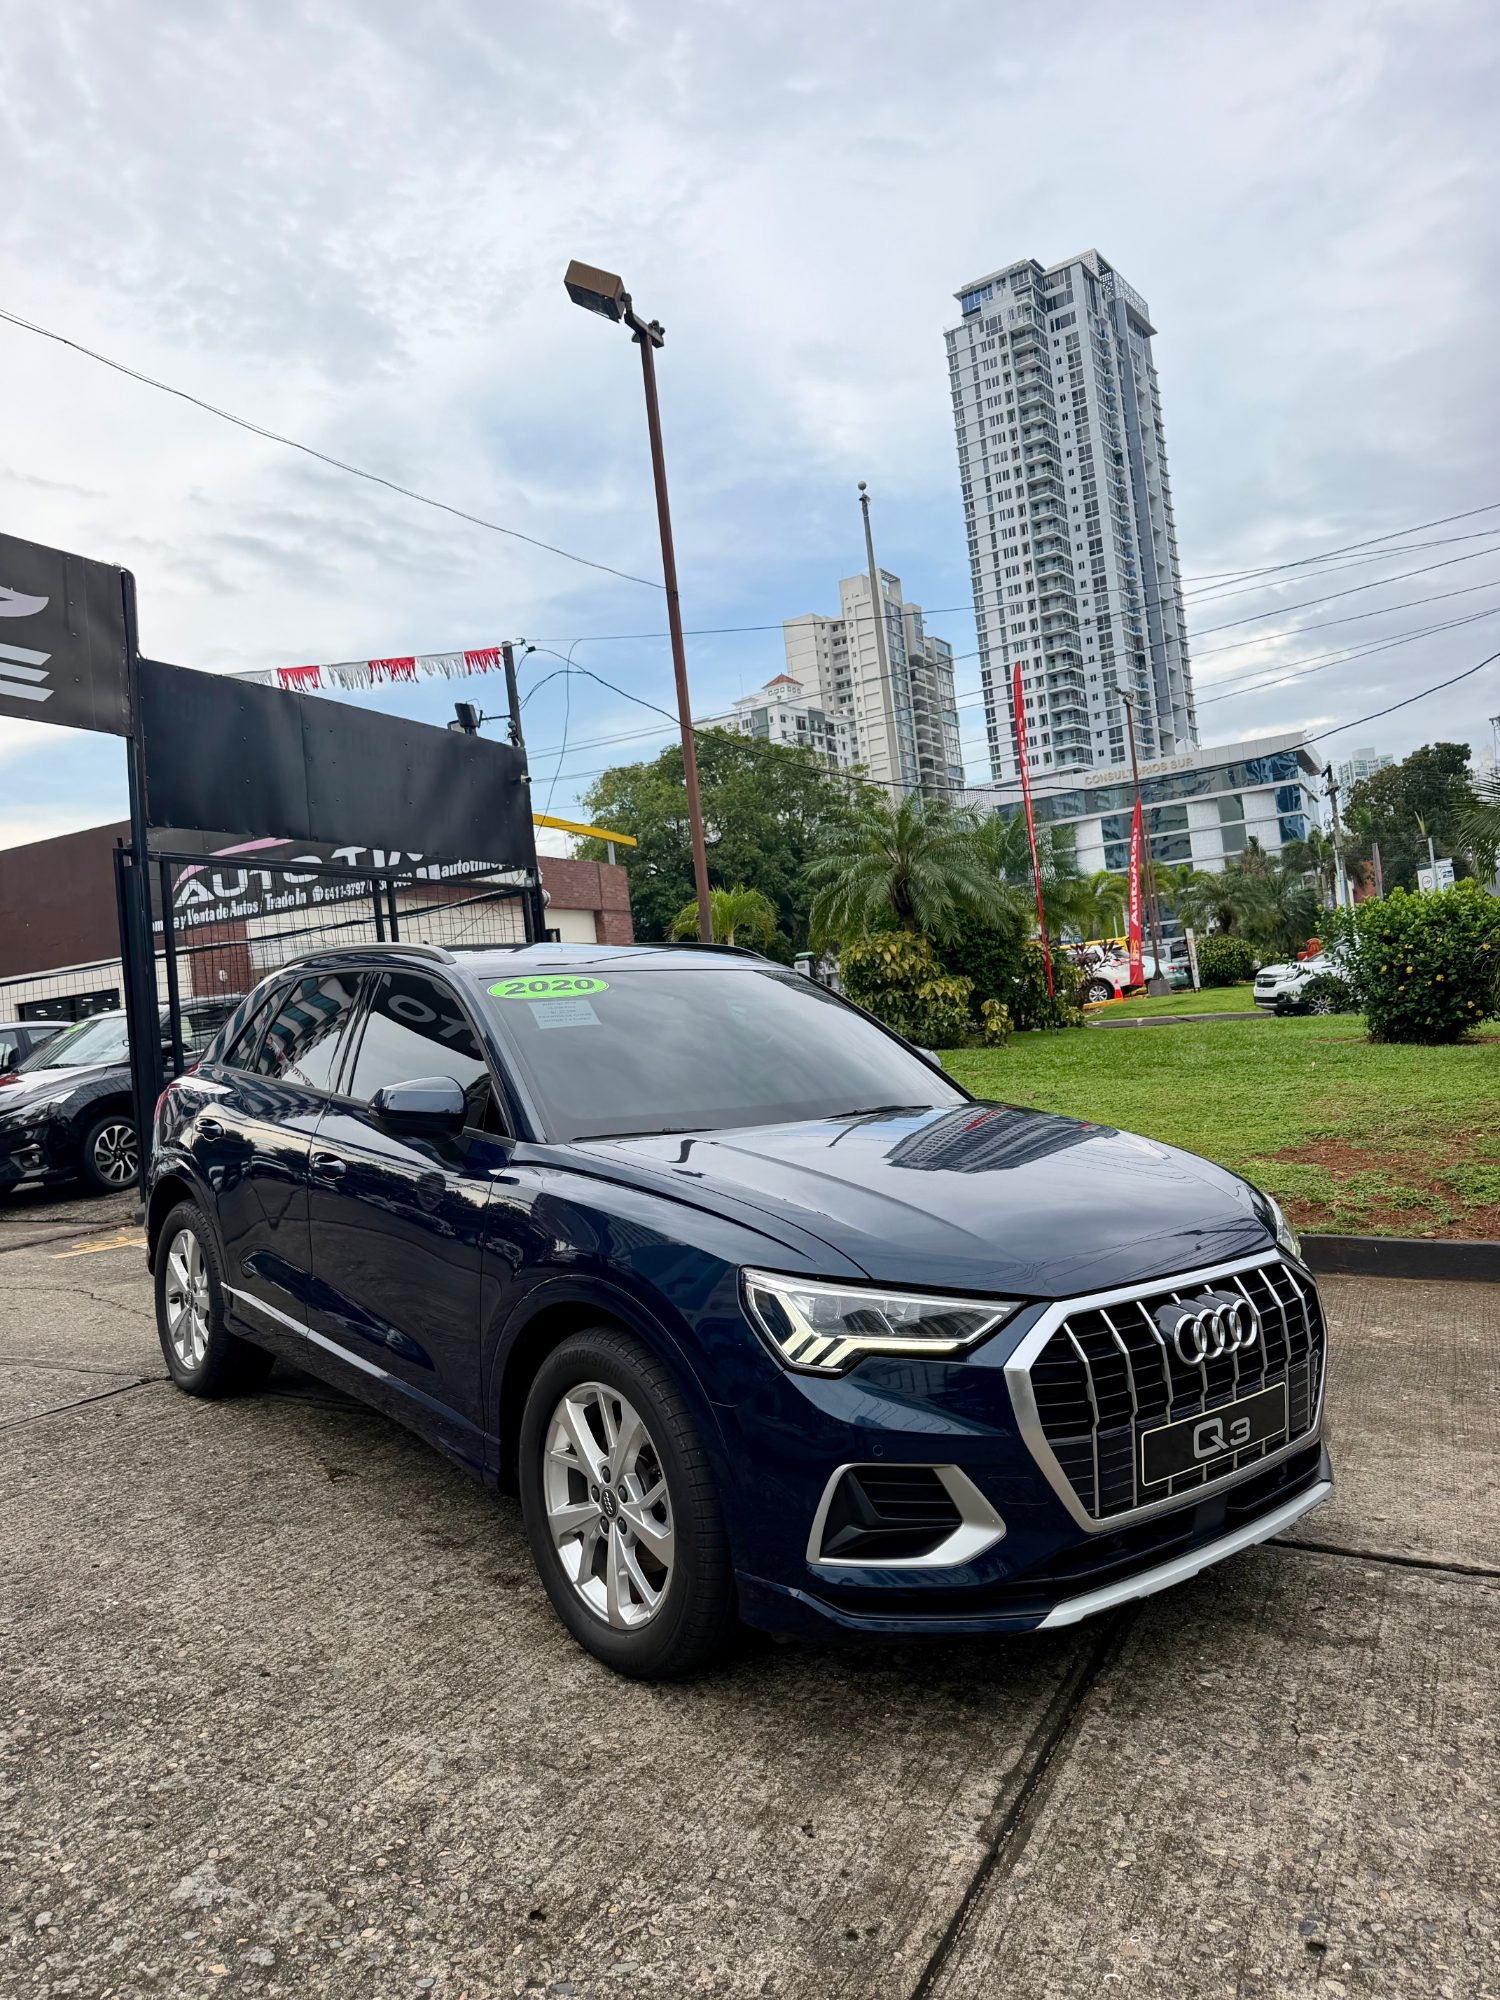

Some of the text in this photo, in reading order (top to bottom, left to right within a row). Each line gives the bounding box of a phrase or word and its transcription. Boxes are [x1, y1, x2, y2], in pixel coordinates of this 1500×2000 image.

[1084, 757, 1194, 786] CONSULTORIOS SUR
[187, 908, 215, 925] Venta
[216, 903, 228, 919] de
[230, 900, 258, 917] Autos
[265, 891, 295, 910] Trade
[505, 979, 595, 996] 2020
[1193, 1417, 1251, 1459] Q3
